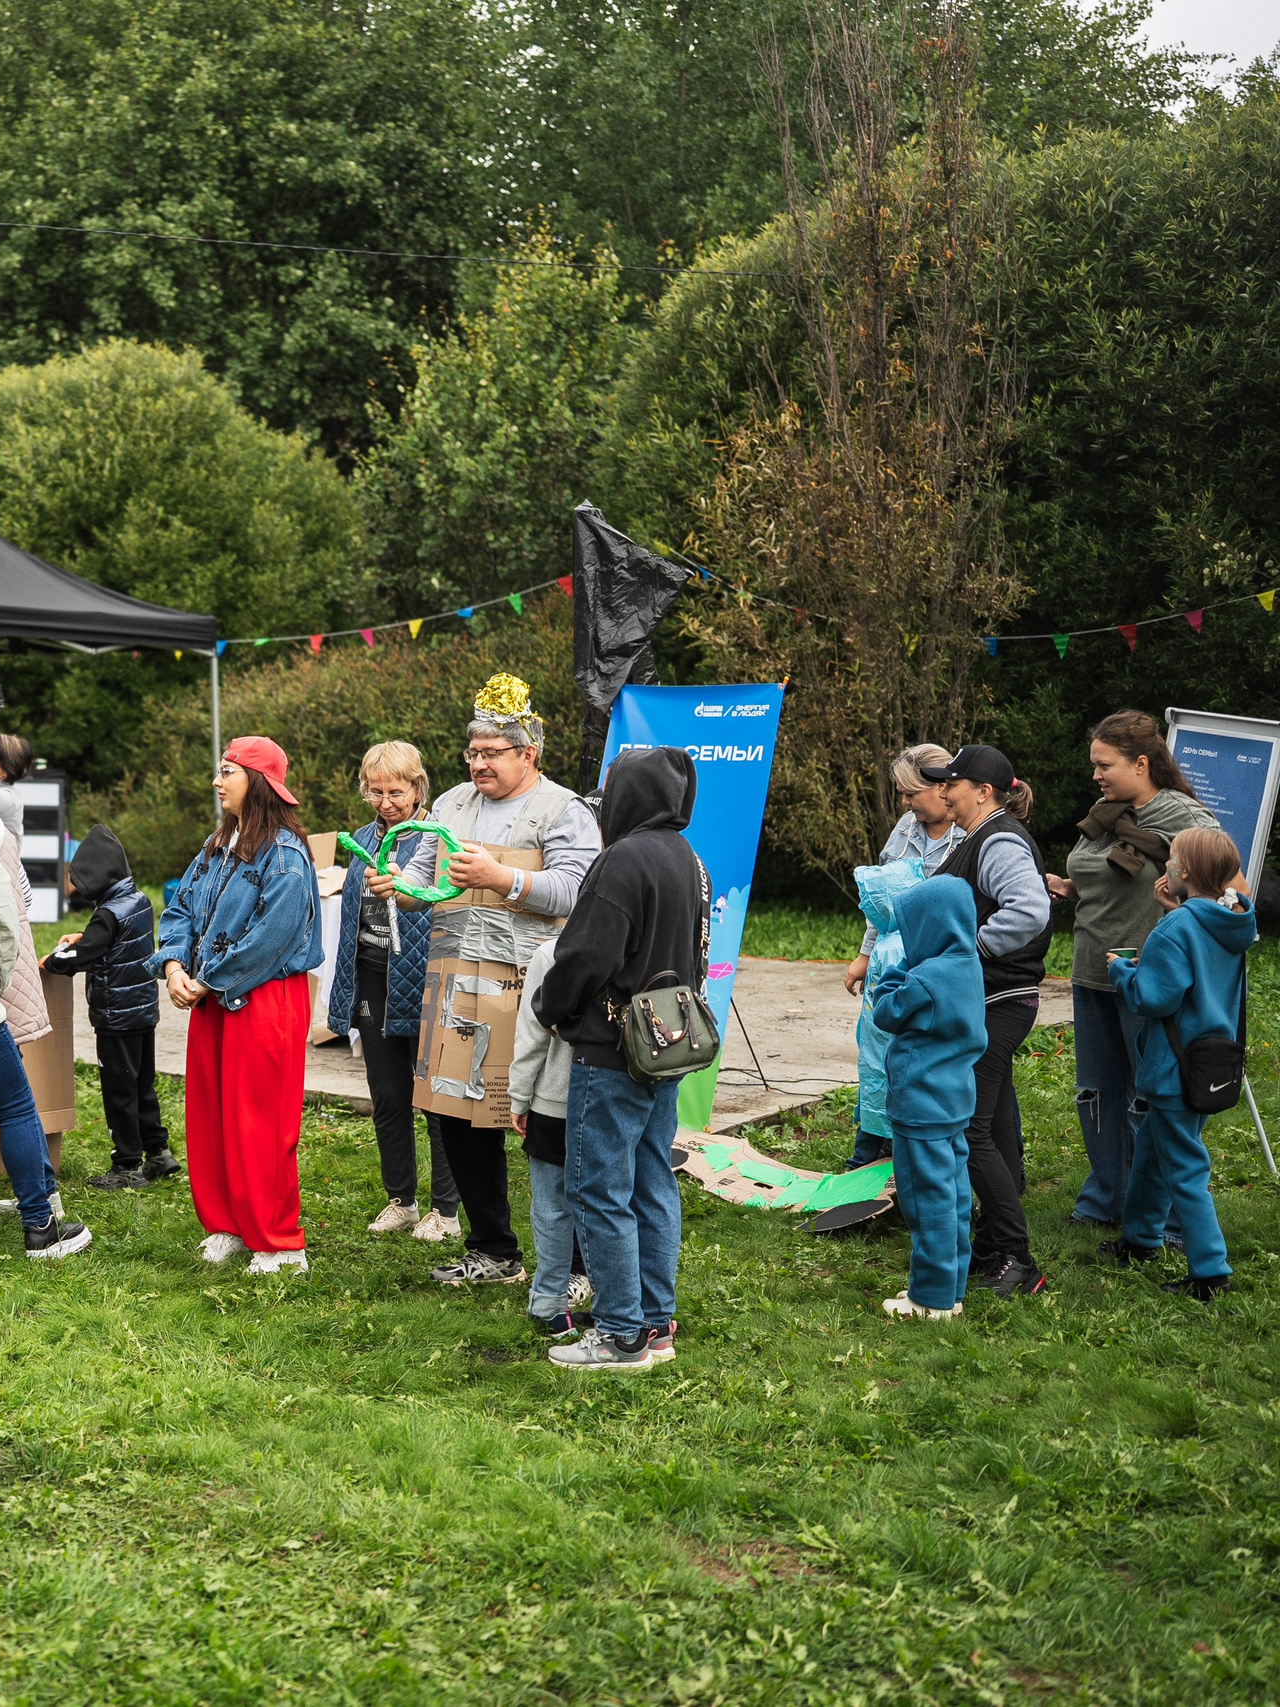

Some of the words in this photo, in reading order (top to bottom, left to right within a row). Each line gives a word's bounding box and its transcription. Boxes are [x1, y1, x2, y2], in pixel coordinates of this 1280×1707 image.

[685, 745, 764, 761] СЕМЬИ
[1182, 746, 1198, 755] ДЕНЬ
[1198, 748, 1218, 757] СЕМЬИ
